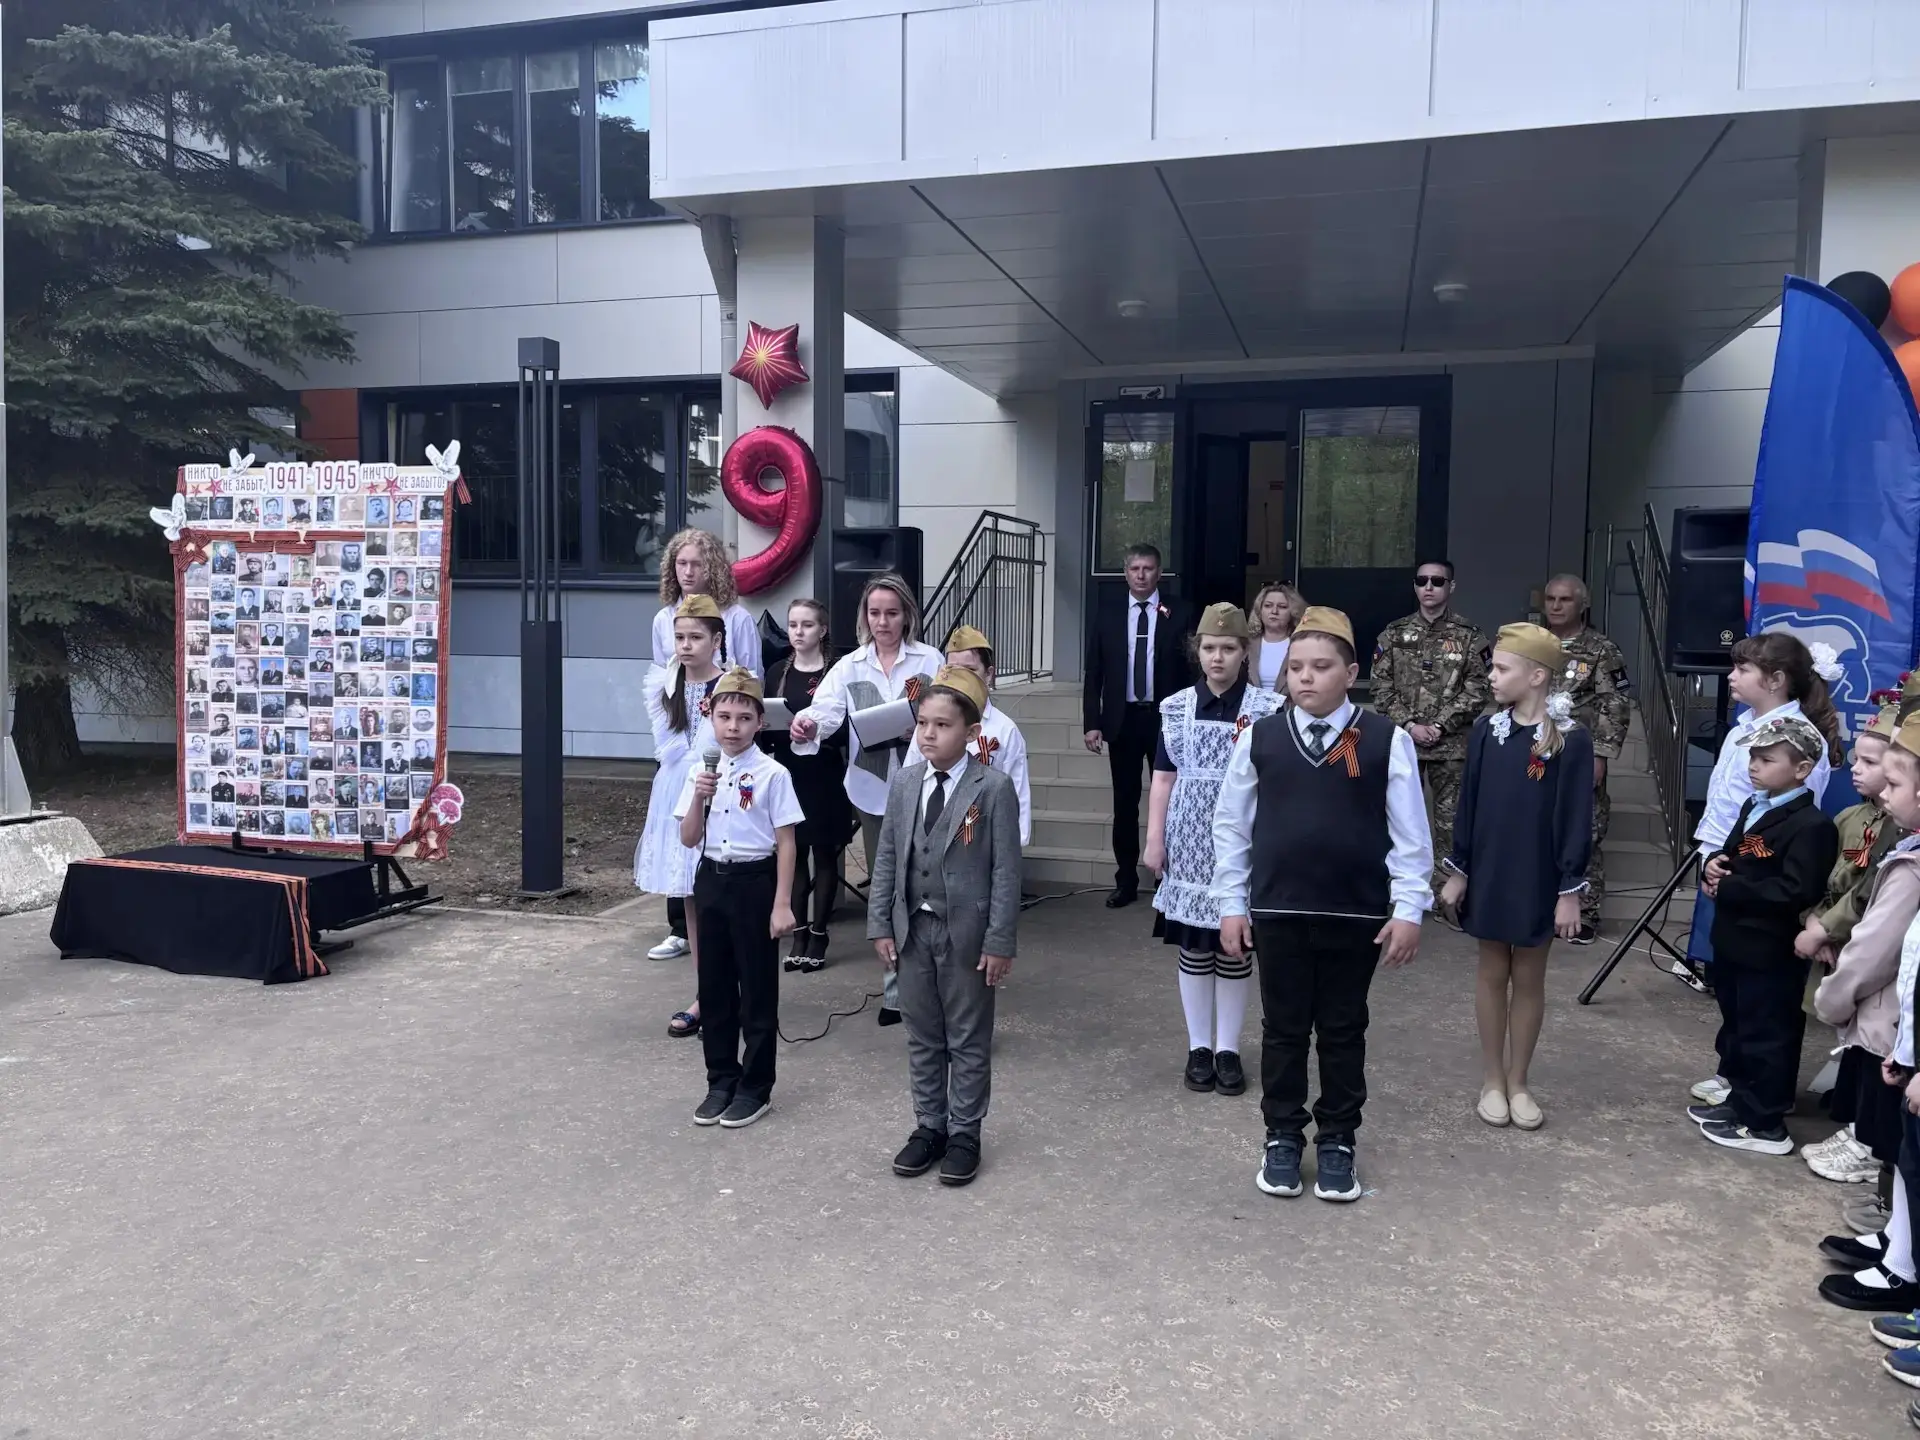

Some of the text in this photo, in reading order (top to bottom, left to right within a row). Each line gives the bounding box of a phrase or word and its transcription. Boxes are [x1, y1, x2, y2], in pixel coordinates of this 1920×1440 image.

[187, 466, 219, 480] НИКТО
[362, 466, 394, 480] НИЧТО
[223, 478, 266, 492] НЕ ЗАБЫТ,
[400, 476, 445, 489] НЕ ЗАБЫТО!
[721, 425, 823, 596] 9
